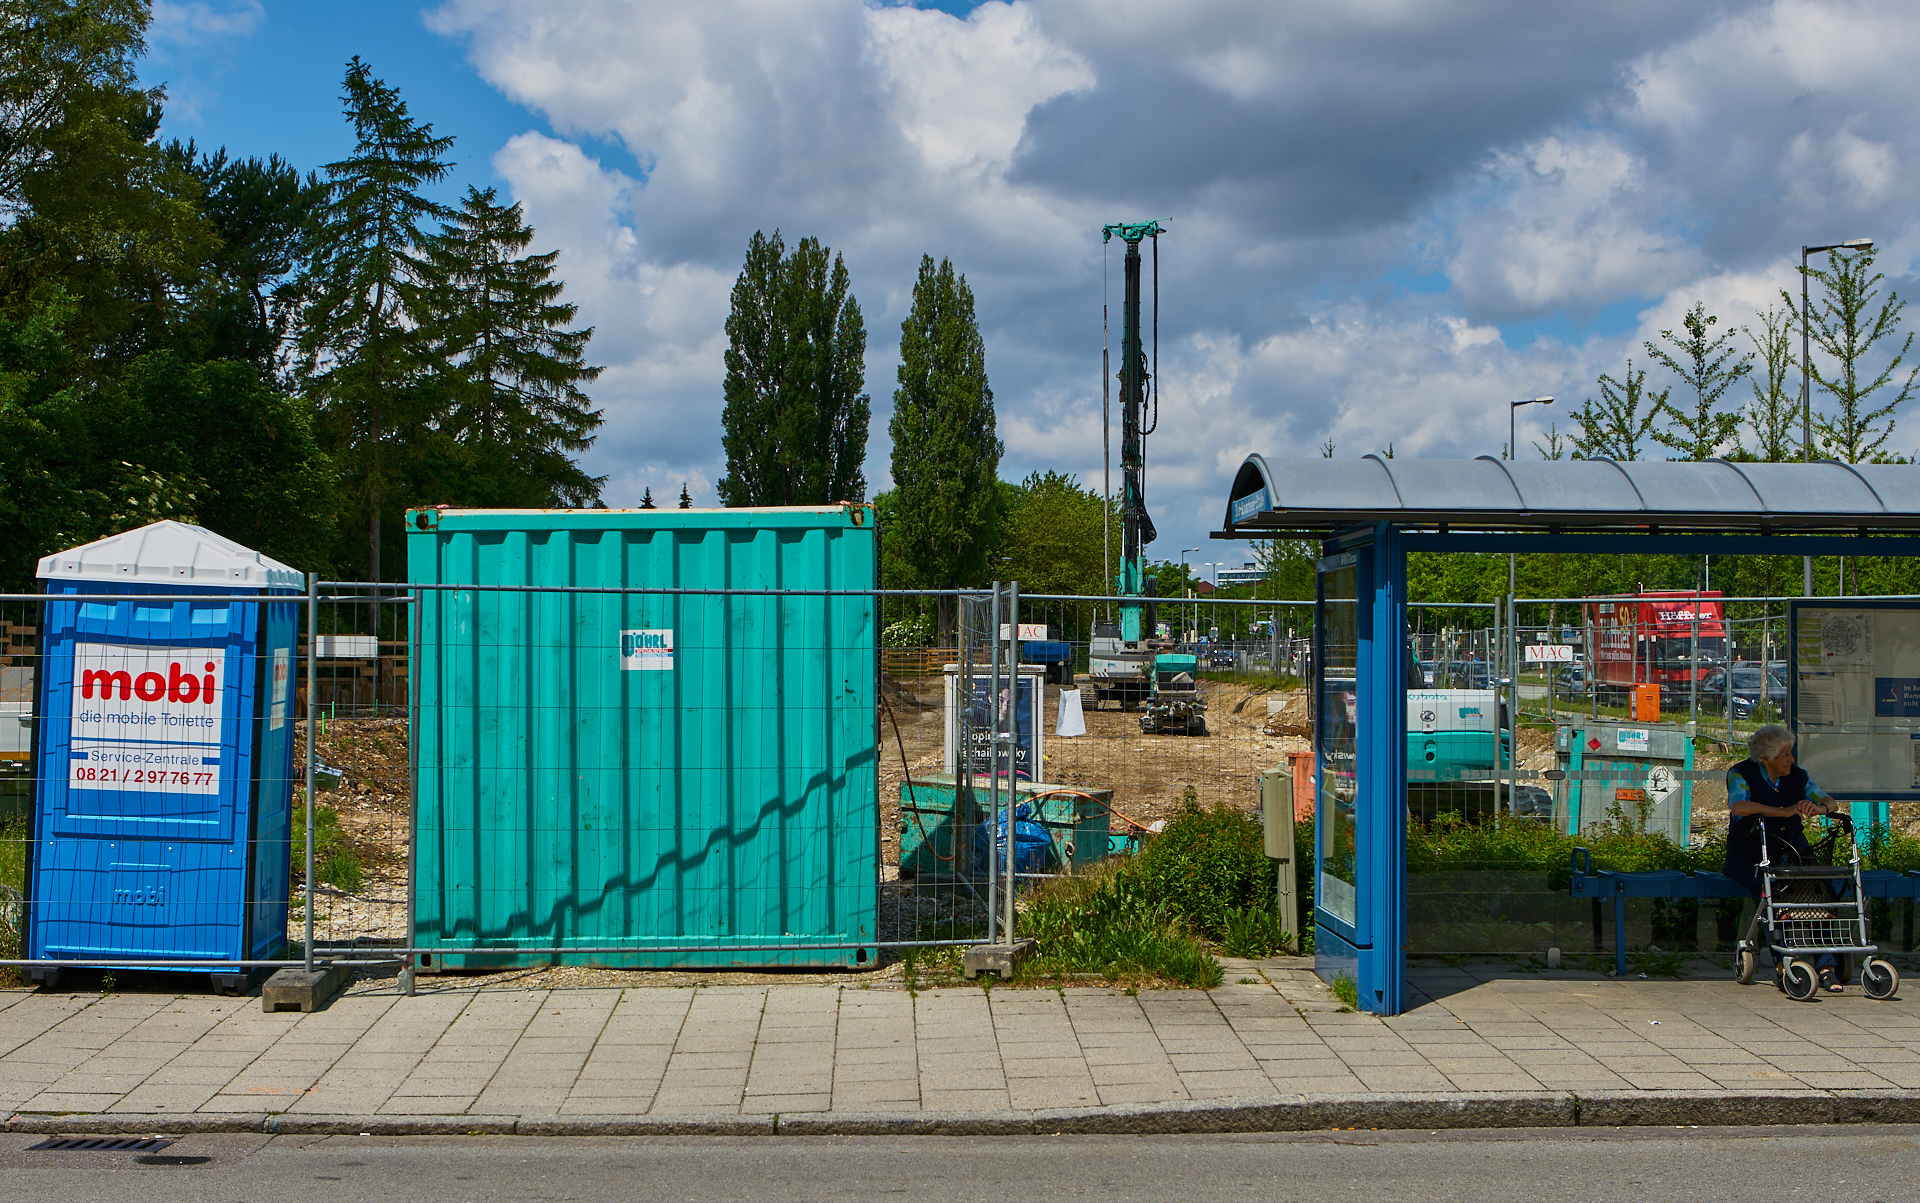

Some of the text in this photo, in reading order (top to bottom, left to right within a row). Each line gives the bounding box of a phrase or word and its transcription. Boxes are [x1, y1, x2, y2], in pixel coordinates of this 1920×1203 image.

[1530, 647, 1569, 659] MAC
[82, 661, 216, 705] mobi
[80, 710, 214, 727] die mobile Toilette
[91, 750, 200, 765] Service-Zentrale
[114, 885, 165, 907] mobi
